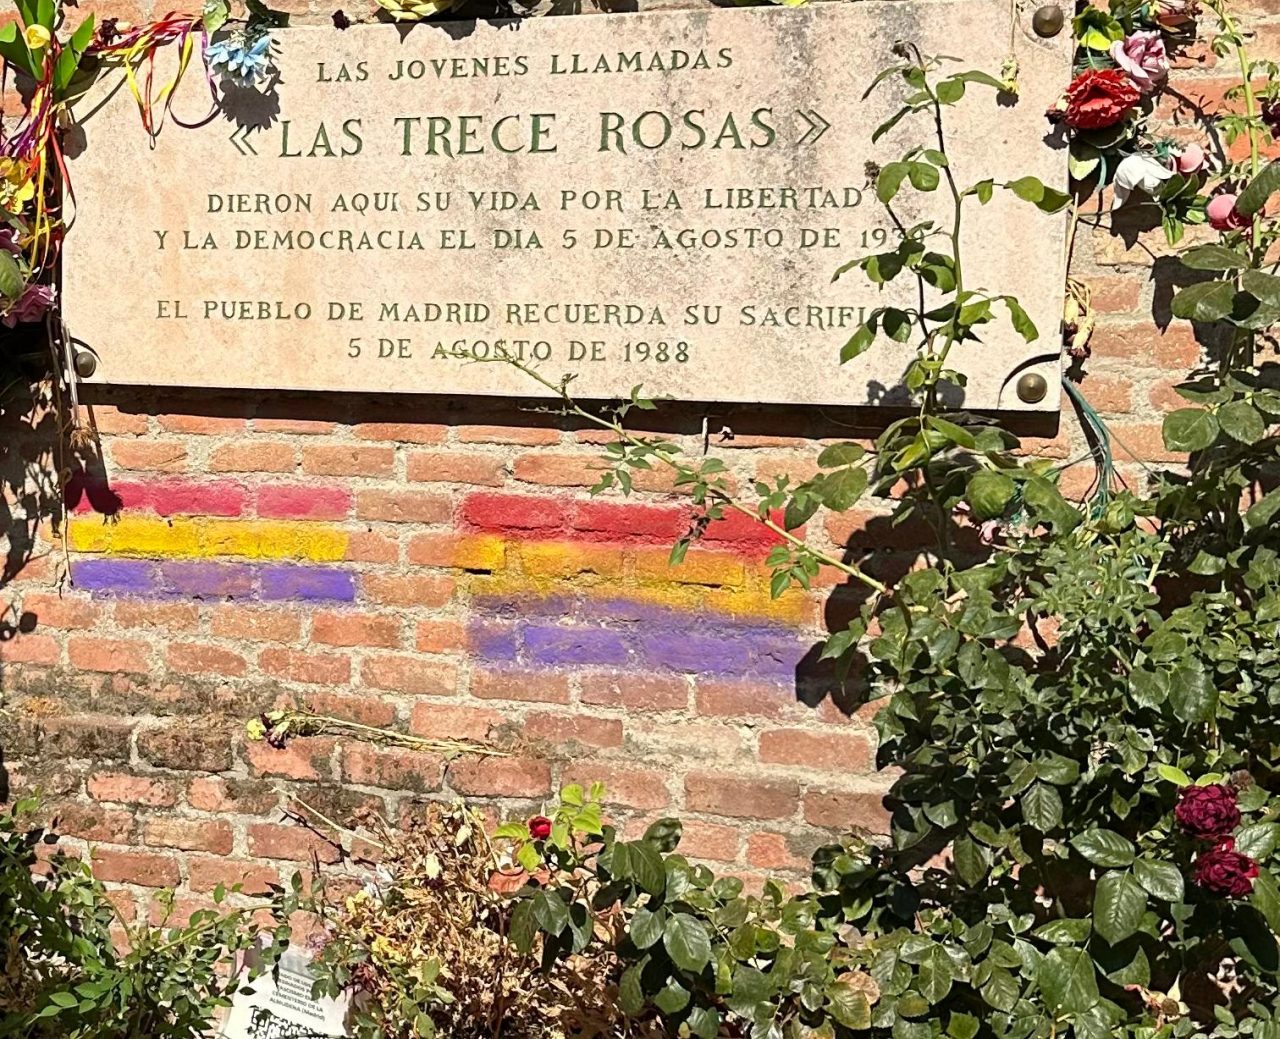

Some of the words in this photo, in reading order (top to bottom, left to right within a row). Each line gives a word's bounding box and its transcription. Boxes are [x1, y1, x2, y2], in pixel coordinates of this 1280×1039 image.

[315, 60, 369, 83] LAS
[387, 55, 529, 81] JOVENES
[549, 47, 733, 77] LLAMADAS
[393, 113, 558, 160] TRECE
[207, 193, 312, 215] DIERON
[330, 192, 399, 215] AQUI
[416, 191, 452, 212] SU
[468, 191, 541, 212] VIDA
[560, 189, 624, 213] POR
[641, 189, 683, 214] LA
[703, 185, 862, 213] LIBERTAD
[153, 230, 169, 250] Y
[182, 230, 218, 250] LA
[234, 229, 426, 251] DEMOCRACIA
[439, 229, 476, 251] EL
[493, 228, 544, 250] DIA
[562, 229, 577, 250] 5
[593, 228, 635, 250] DE
[652, 227, 785, 250] AGOSTO
[798, 228, 841, 250] DE
[156, 300, 188, 319] EL
[203, 300, 312, 320] PUEBLO
[327, 302, 364, 321] DE
[378, 302, 490, 326] MADRID
[505, 303, 666, 328] RECUERDA
[683, 303, 723, 326] SU
[347, 337, 362, 359] 5
[377, 338, 413, 359] DE
[431, 339, 552, 362] AGOSTO
[568, 340, 606, 362] DE
[623, 341, 690, 364] 1988
